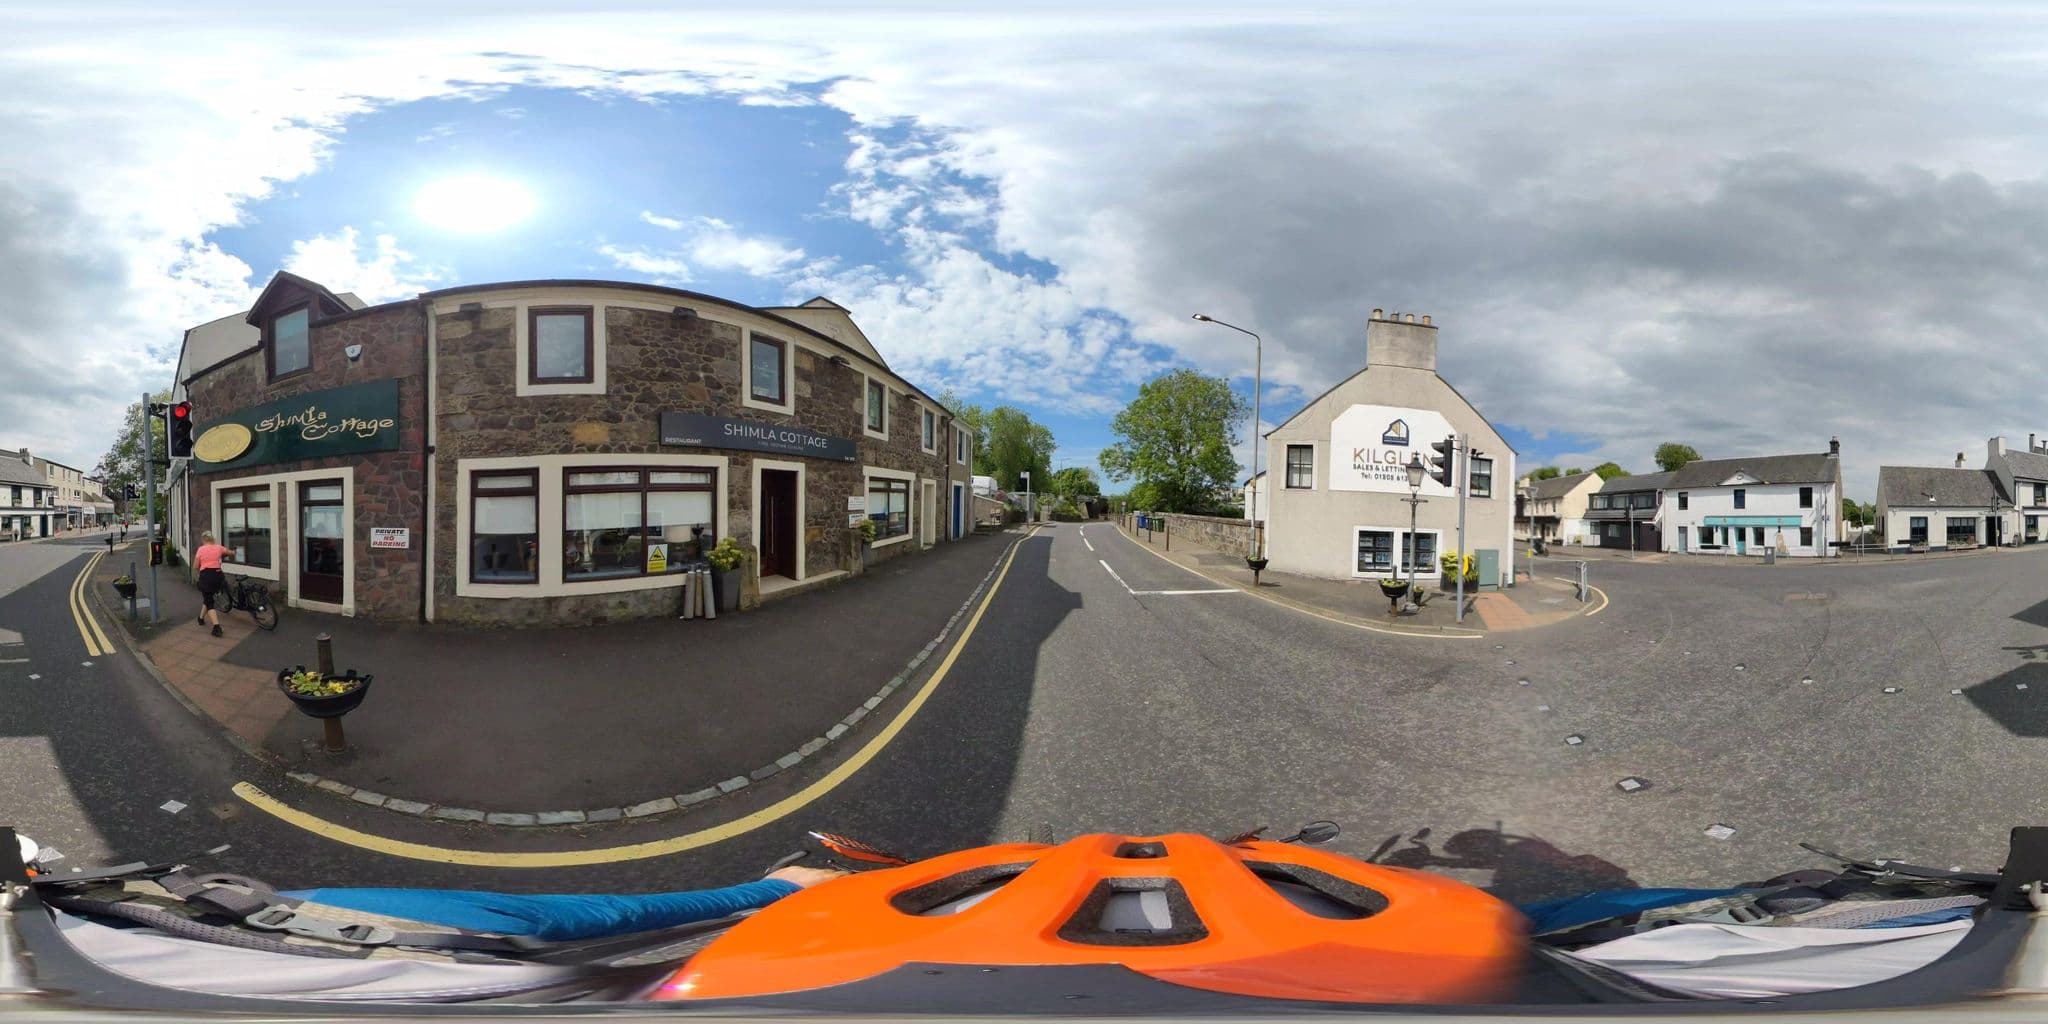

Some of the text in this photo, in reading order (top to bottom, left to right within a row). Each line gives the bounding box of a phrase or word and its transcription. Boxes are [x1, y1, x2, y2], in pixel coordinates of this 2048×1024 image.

[302, 417, 394, 440] Cottage
[724, 423, 776, 440] SHIMLA
[780, 431, 827, 448] COTTAGE
[1381, 465, 1406, 473] LETTIN
